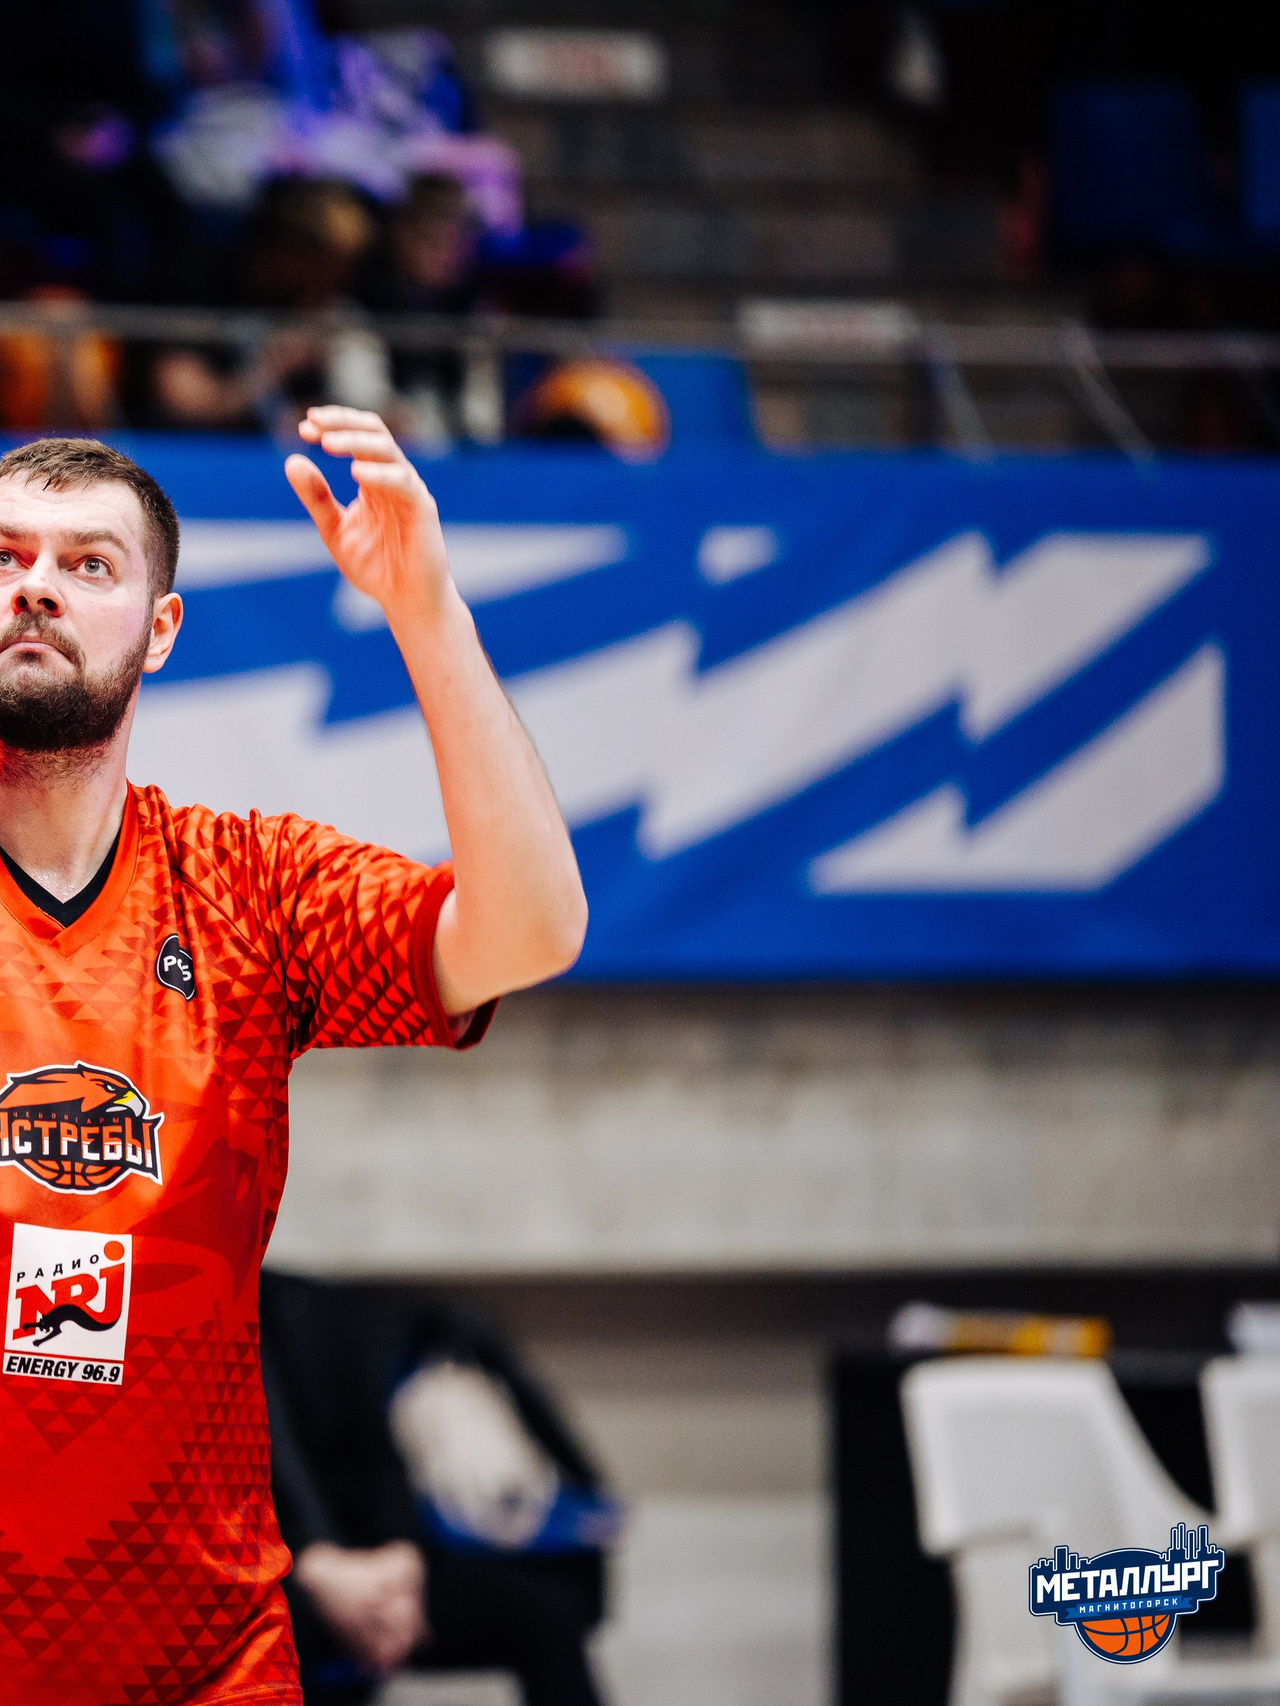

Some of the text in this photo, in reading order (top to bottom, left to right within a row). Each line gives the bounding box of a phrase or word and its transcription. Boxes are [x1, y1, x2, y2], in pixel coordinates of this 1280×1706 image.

[16, 1254, 100, 1283] РАДИО
[5, 1355, 121, 1382] ENERGY 96.9
